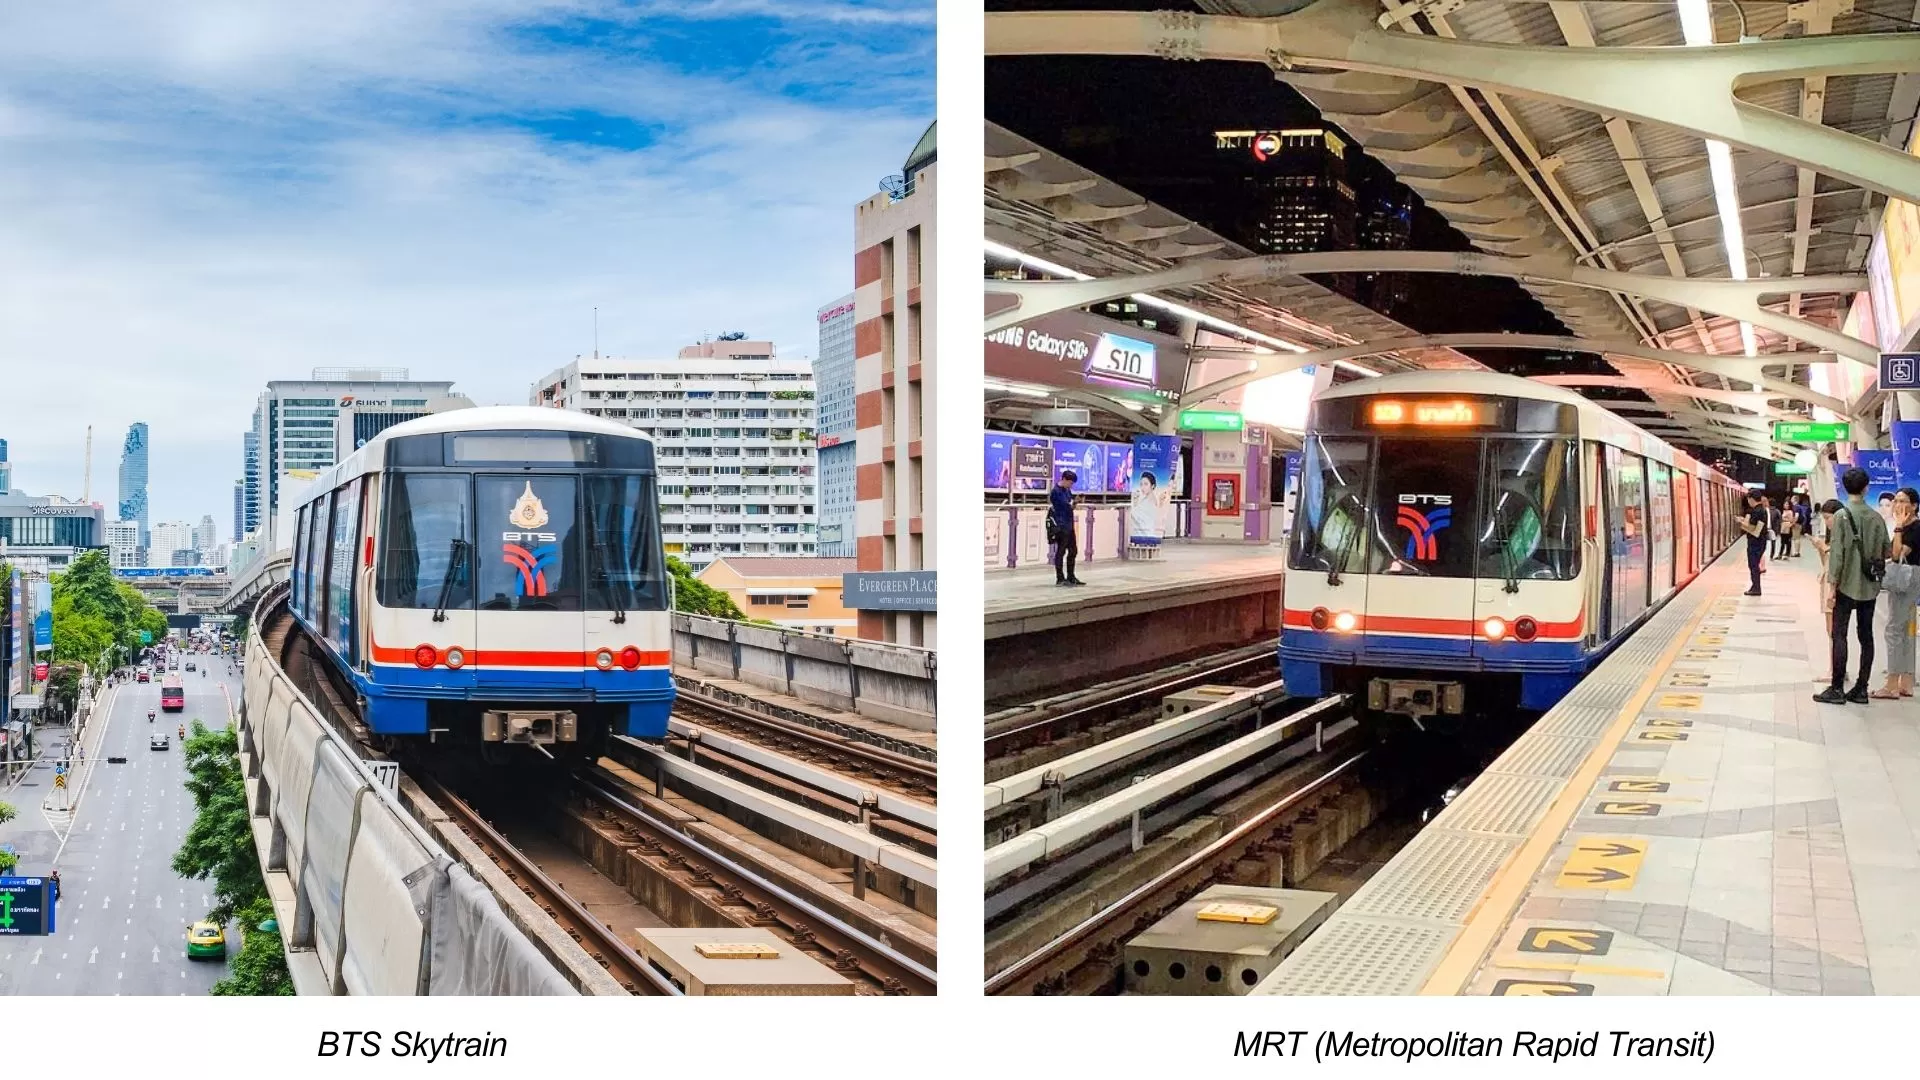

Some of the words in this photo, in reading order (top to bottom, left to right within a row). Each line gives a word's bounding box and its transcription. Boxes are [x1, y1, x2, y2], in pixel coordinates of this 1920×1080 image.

[1027, 330, 1068, 361] Galaxy
[1398, 493, 1452, 505] BTS
[502, 531, 557, 542] BTS
[859, 578, 908, 592] EVERGREEN
